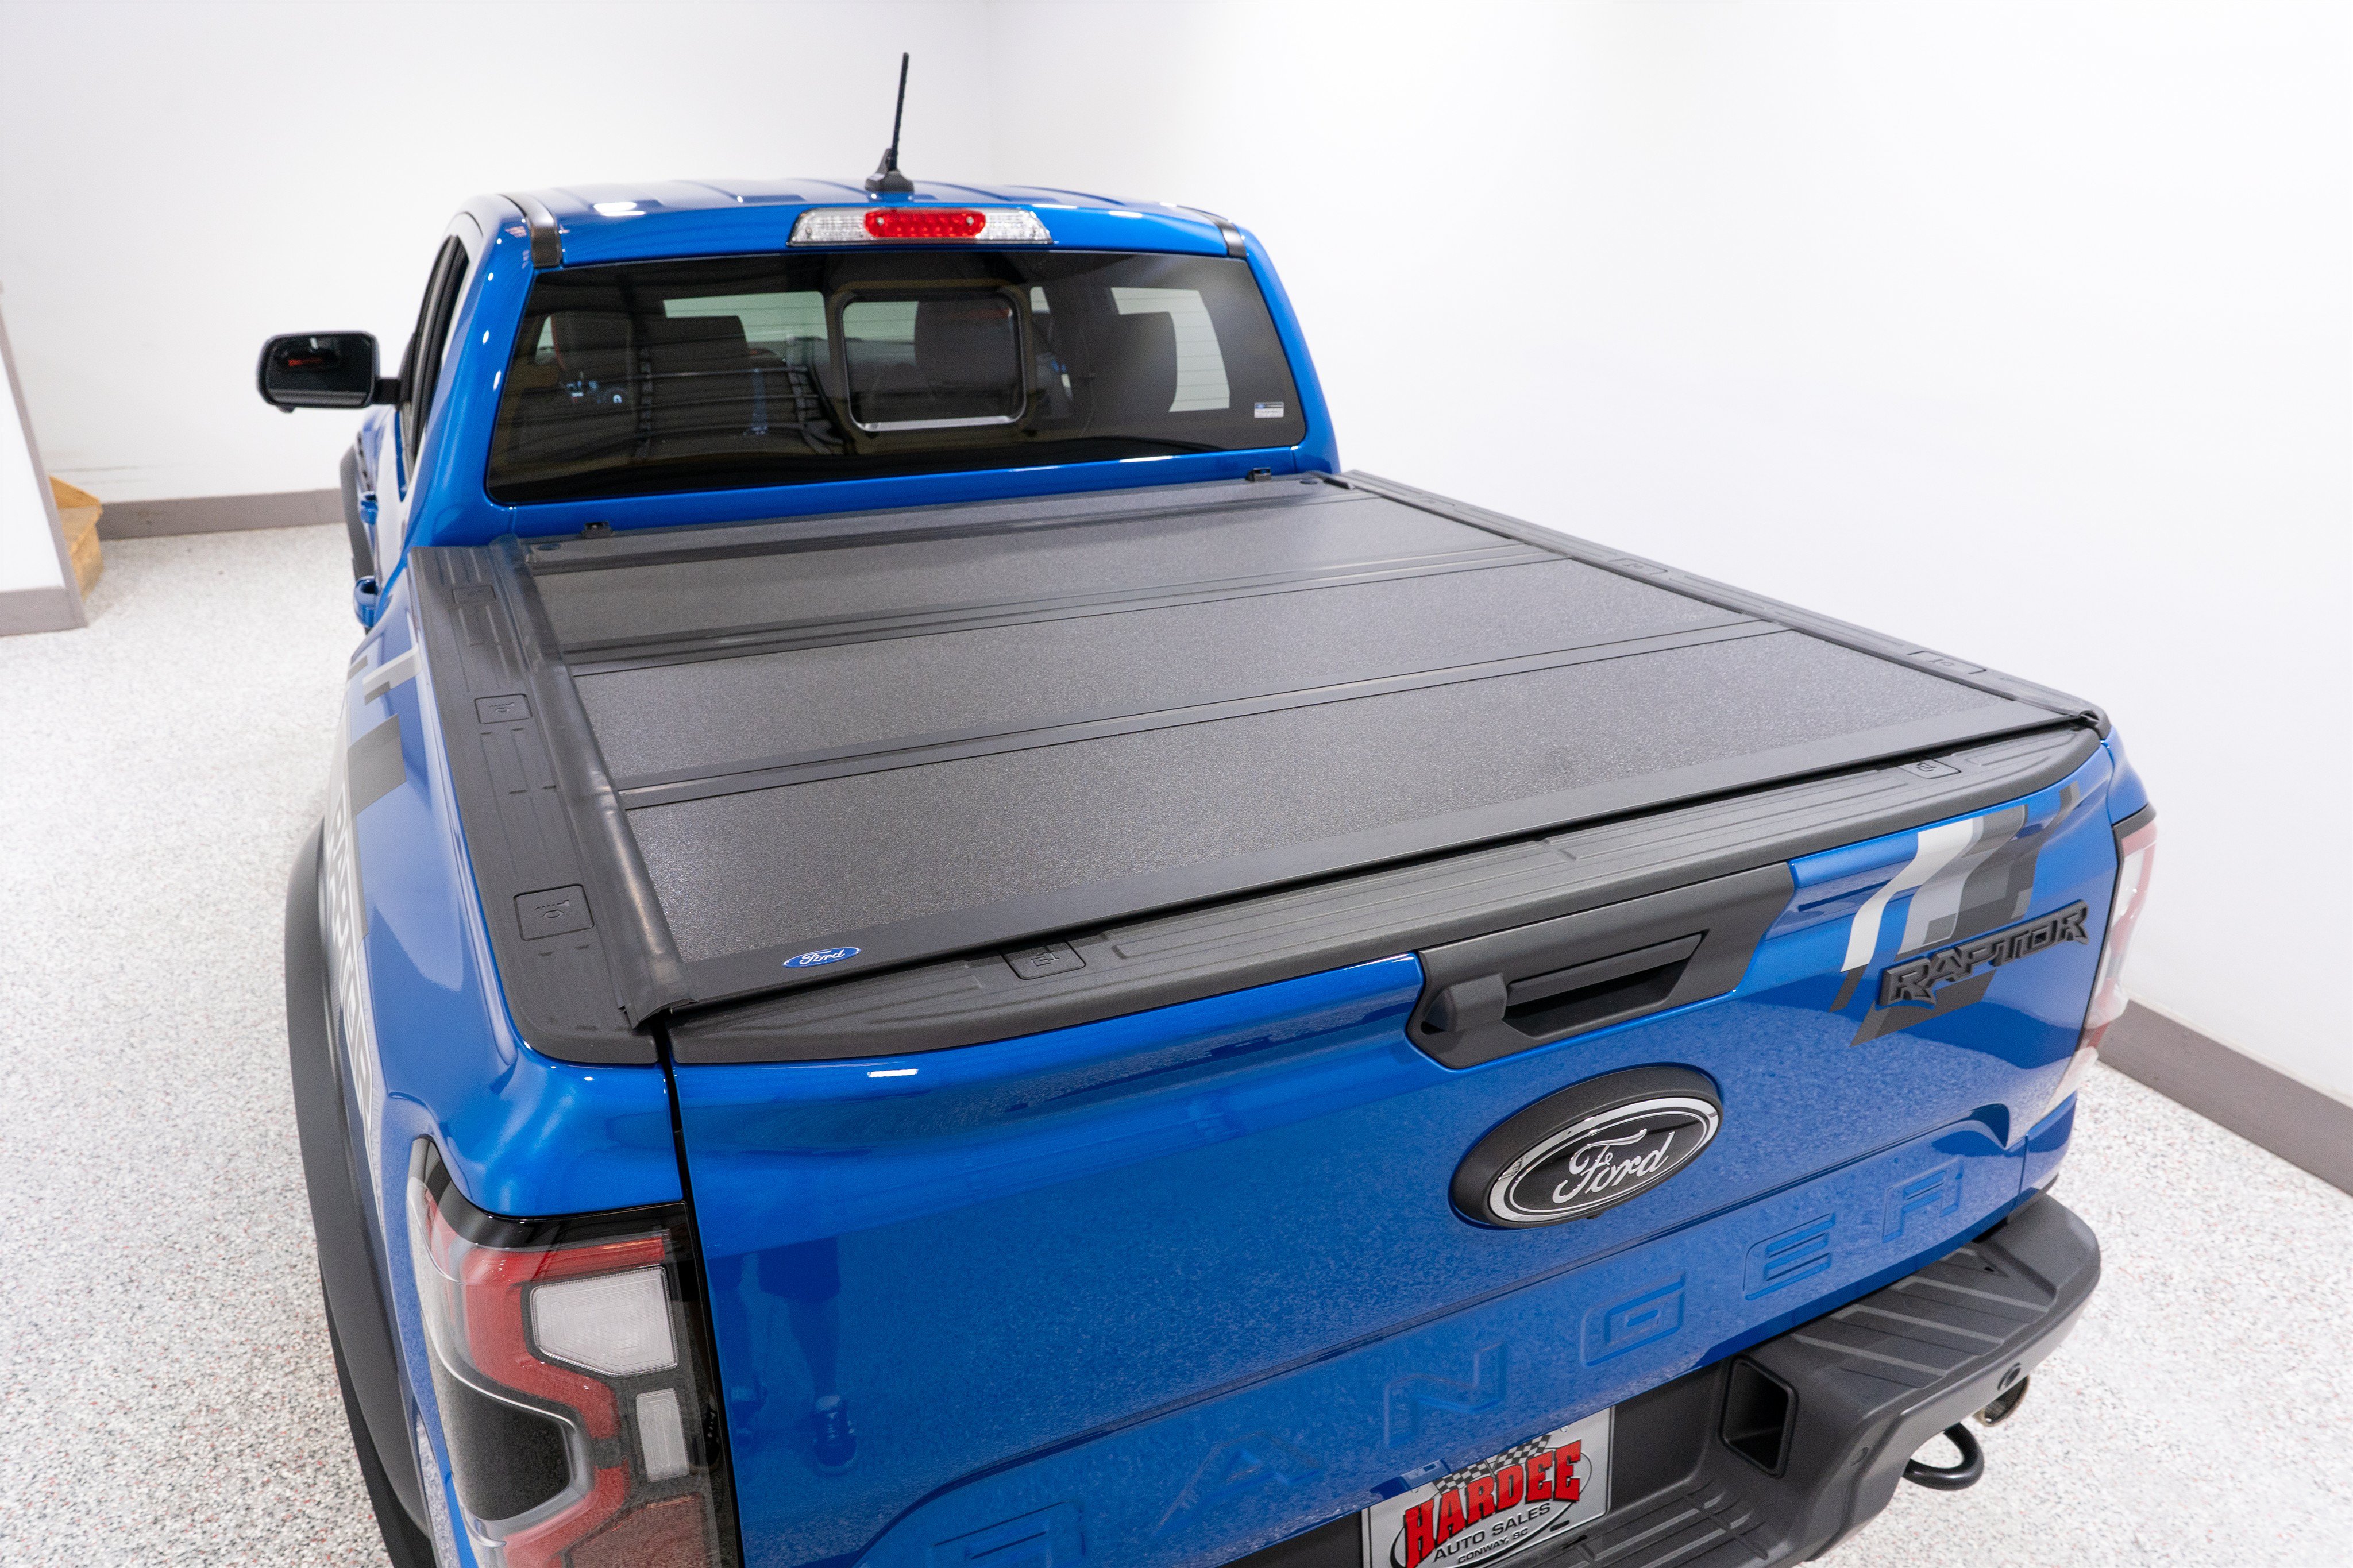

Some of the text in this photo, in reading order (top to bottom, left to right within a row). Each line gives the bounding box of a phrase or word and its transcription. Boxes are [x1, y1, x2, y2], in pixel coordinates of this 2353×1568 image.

[799, 949, 846, 965] Ford
[1876, 899, 2089, 1009] RAPTOR
[1552, 1128, 1675, 1204] Ford
[1403, 1439, 1582, 1568] HARDEE
[1433, 1502, 1551, 1563] AUTO SALES
[1457, 1527, 1529, 1565] CONWAY, SC
